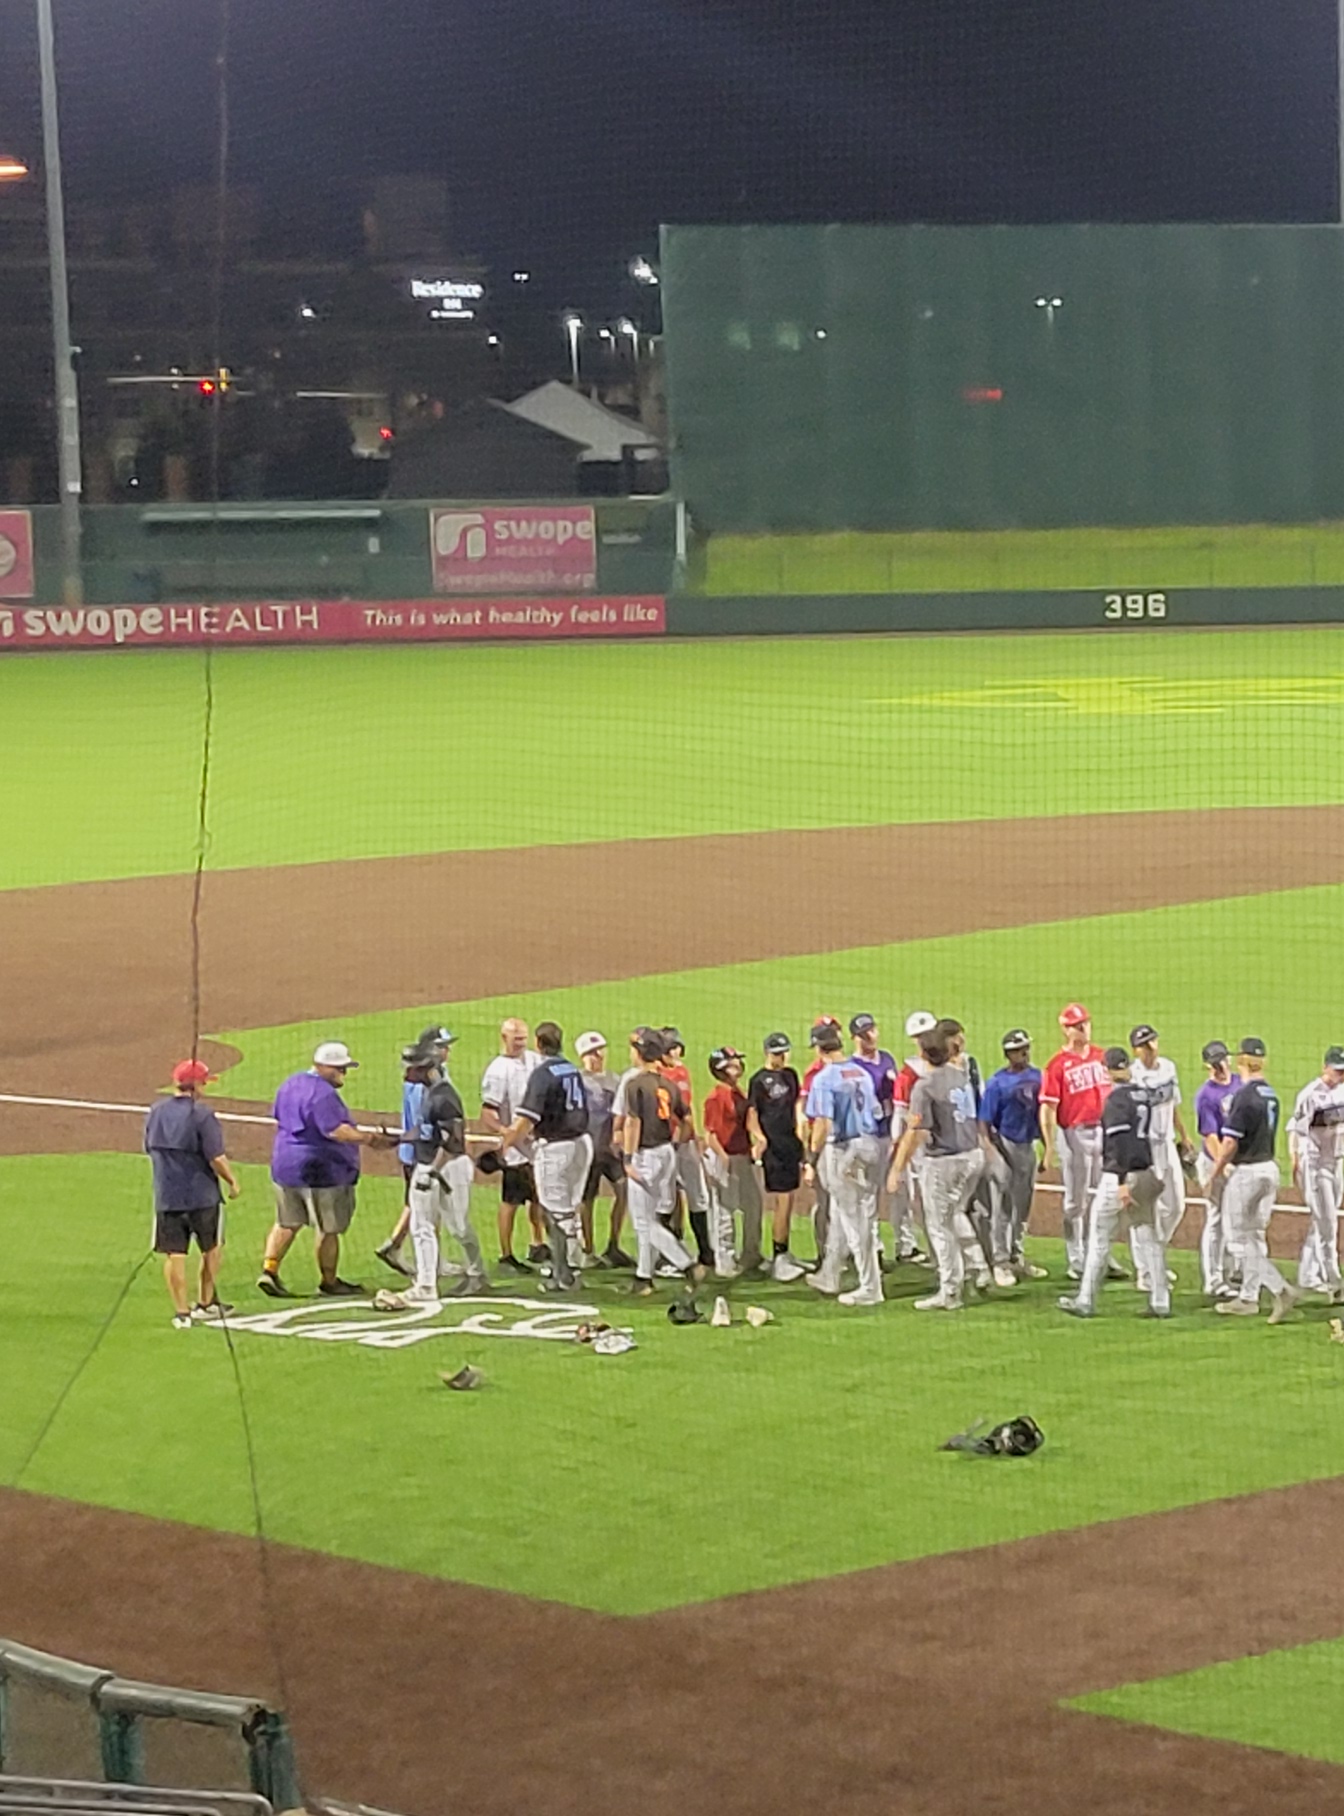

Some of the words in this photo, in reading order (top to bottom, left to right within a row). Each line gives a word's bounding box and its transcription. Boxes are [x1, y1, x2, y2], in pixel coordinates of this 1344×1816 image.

[411, 279, 484, 298] Residence
[493, 519, 594, 546] swope
[363, 609, 402, 627] This
[410, 609, 426, 626] is
[432, 608, 482, 626] what
[488, 605, 563, 628] healthy
[570, 604, 618, 624] feels
[622, 603, 658, 622] like
[1104, 593, 1167, 619] 396
[23, 606, 164, 643] swope
[169, 605, 319, 634] HEALTH
